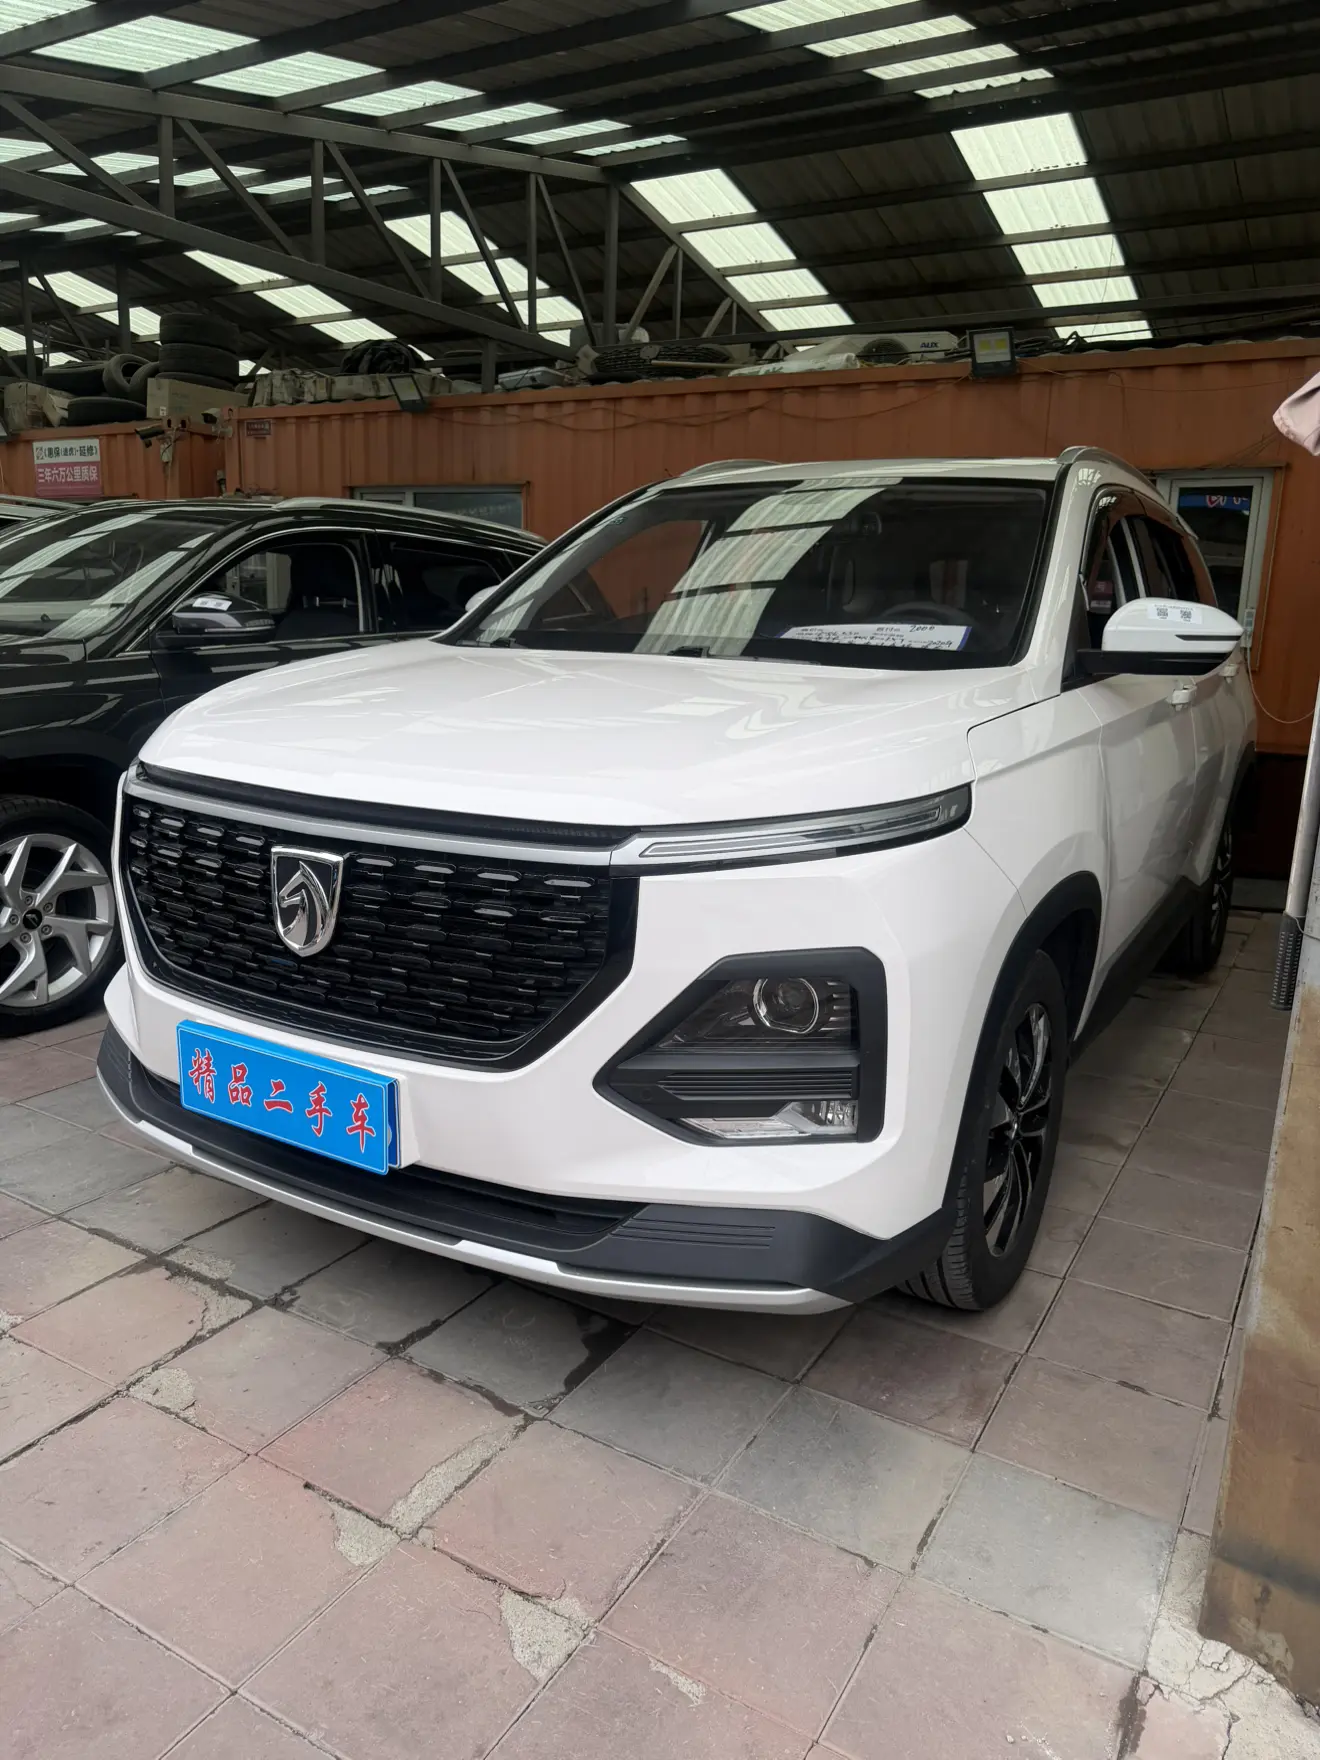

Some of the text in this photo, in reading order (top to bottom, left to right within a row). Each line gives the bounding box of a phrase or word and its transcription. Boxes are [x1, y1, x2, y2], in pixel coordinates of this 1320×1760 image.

[919, 341, 939, 349] AUX
[37, 465, 98, 483] 三年六万公里质保
[188, 1047, 377, 1154] 精品二手车
